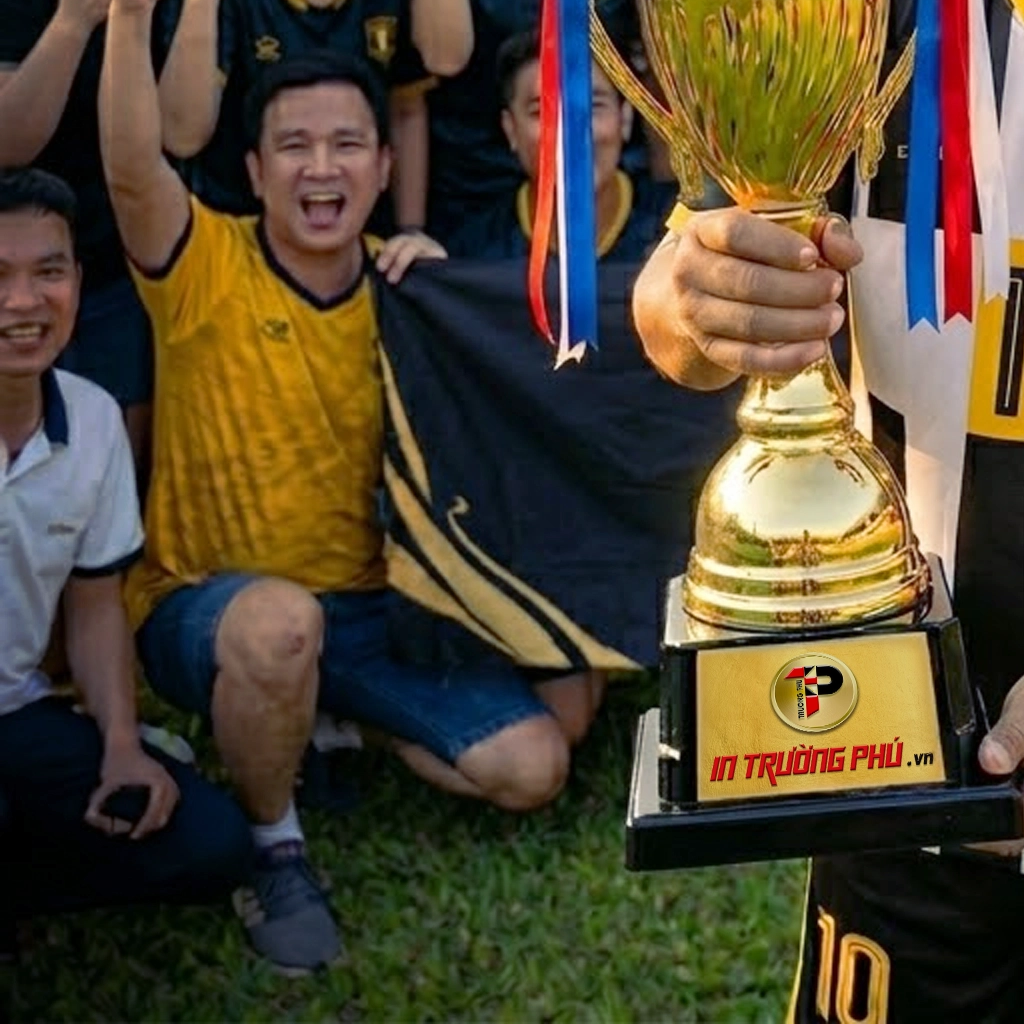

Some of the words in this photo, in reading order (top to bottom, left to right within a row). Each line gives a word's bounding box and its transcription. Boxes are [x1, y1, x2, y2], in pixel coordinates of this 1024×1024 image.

[709, 755, 738, 782] IN
[744, 744, 846, 787] TRƯỜNG
[850, 736, 903, 771] PHÚ
[816, 904, 891, 1024] 10
